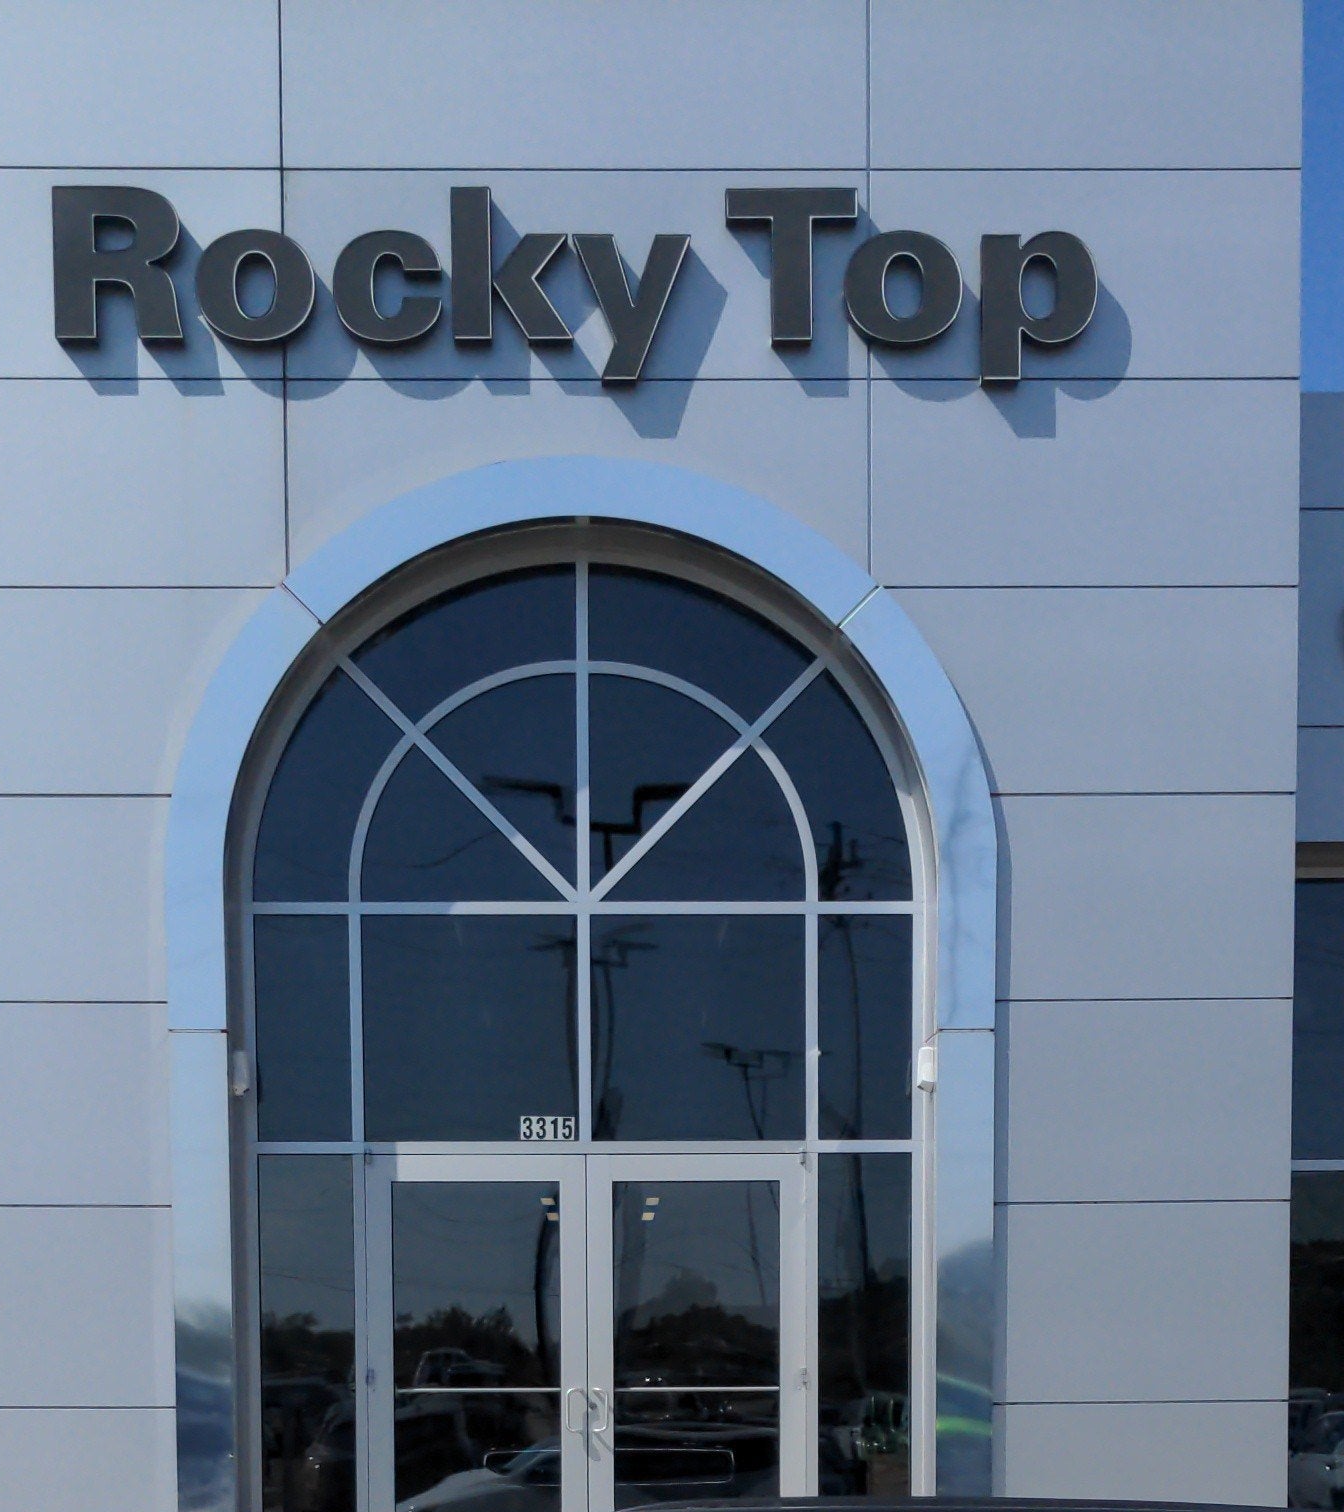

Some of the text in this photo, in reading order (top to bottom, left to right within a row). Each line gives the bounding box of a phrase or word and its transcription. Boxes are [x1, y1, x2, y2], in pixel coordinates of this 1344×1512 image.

[51, 185, 1099, 387] Rocky Top
[522, 1117, 573, 1140] 3315
